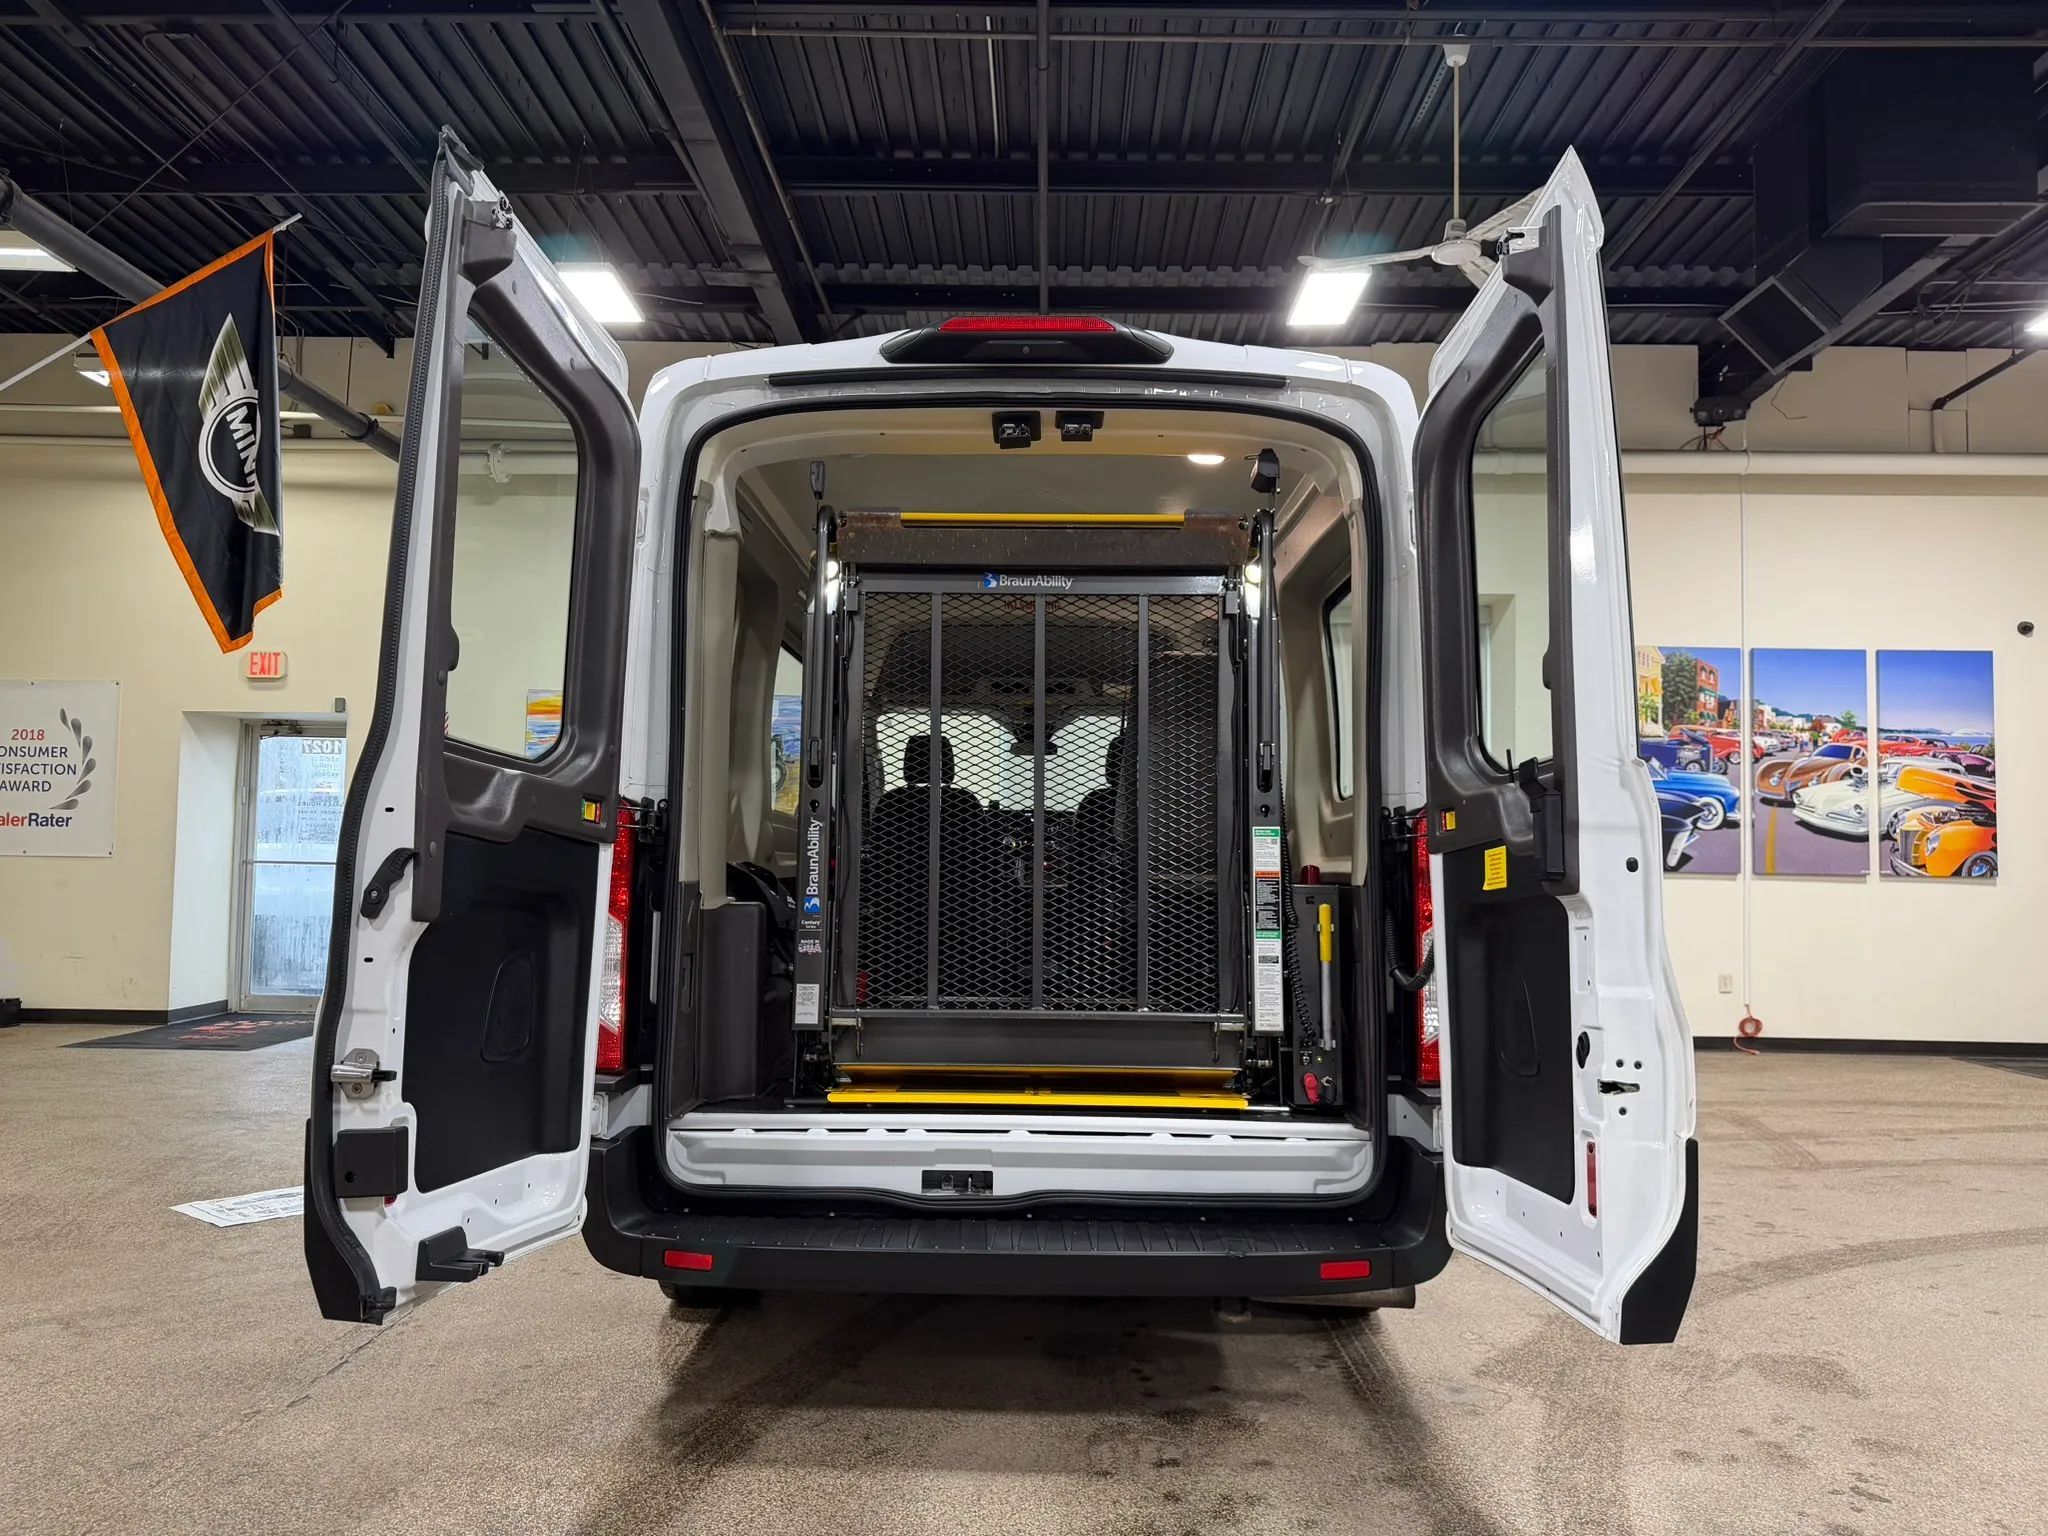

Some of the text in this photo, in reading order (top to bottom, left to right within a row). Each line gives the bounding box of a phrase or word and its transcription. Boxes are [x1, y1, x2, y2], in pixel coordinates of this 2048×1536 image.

[1000, 574, 1073, 590] BraunAbility
[250, 651, 281, 676] EXIT
[11, 728, 45, 741] 2018
[0, 780, 52, 792] AWARD
[806, 817, 823, 895] BraunAbility
